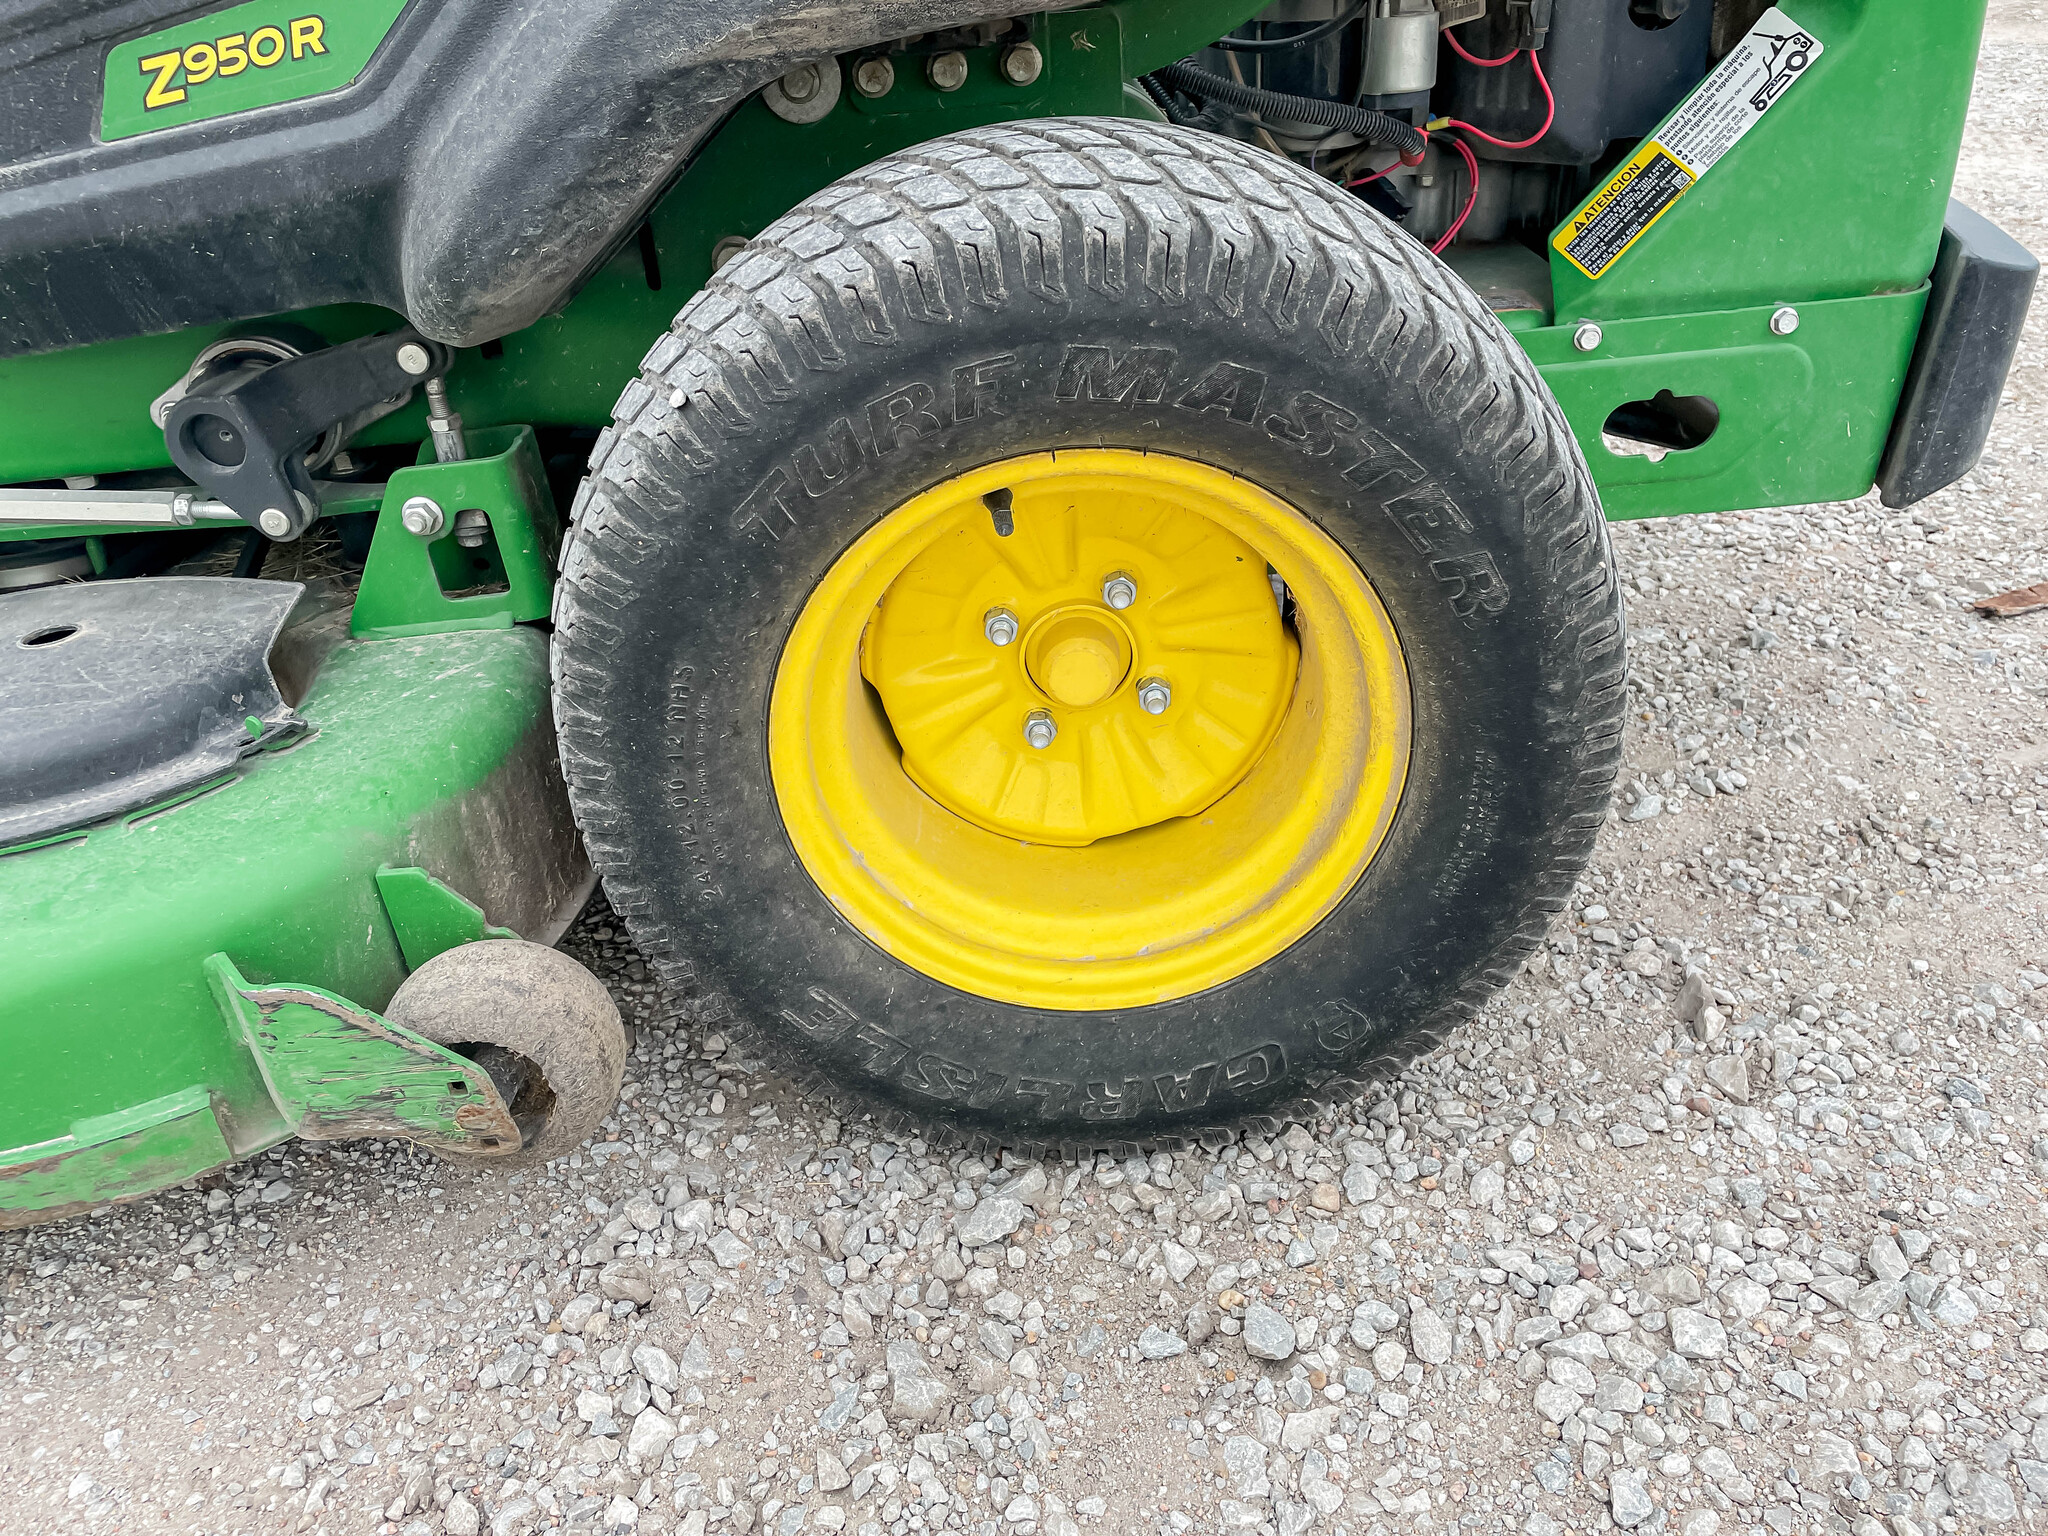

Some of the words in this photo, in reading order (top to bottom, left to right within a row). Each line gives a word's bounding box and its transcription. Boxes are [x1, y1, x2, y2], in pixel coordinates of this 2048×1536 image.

[138, 14, 330, 112] Z950R
[1657, 118, 1680, 141] Revisar
[1682, 92, 1704, 114] limpiar
[1702, 79, 1717, 93] toda
[1722, 44, 1750, 72] máquina,
[1664, 117, 1692, 147] prestando
[1691, 92, 1716, 118] atención
[1714, 66, 1739, 92] especial
[1741, 51, 1753, 62] los
[1714, 95, 1735, 117] sistema
[1734, 87, 1742, 95] de
[1741, 67, 1761, 87] escape
[1670, 131, 1690, 152] puntos
[1688, 99, 1719, 131] siguientes:
[1687, 138, 1704, 154] Motor
[1708, 123, 1719, 134] sus
[1731, 113, 1739, 122] de
[1584, 162, 1640, 221] ATENCION
[729, 353, 1016, 542] TURF
[1052, 343, 1511, 618] MASTER
[781, 985, 1288, 1120] CARLISLE
